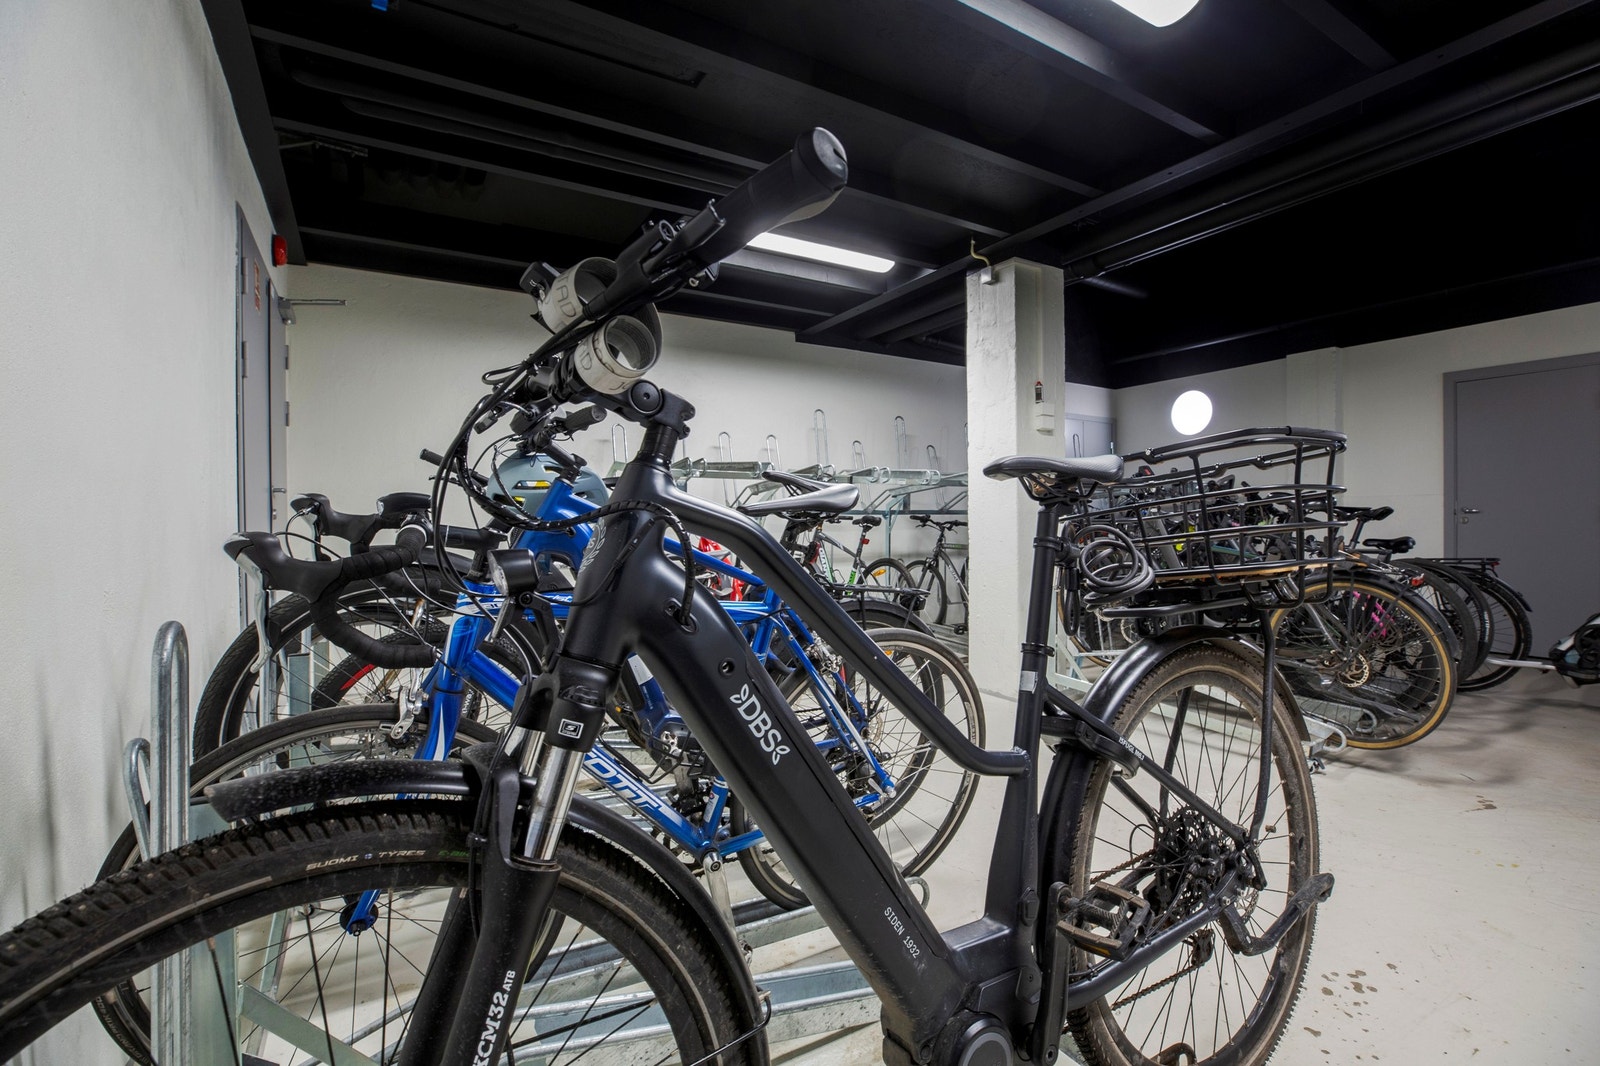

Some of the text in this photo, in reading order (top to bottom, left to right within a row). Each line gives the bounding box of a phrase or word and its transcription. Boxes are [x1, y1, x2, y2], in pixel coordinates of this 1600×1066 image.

[736, 693, 782, 753] DBS
[305, 849, 470, 871] SUOMI TYRES E-BIK
[884, 906, 920, 959] SIDEN 1932
[502, 969, 516, 992] ATB
